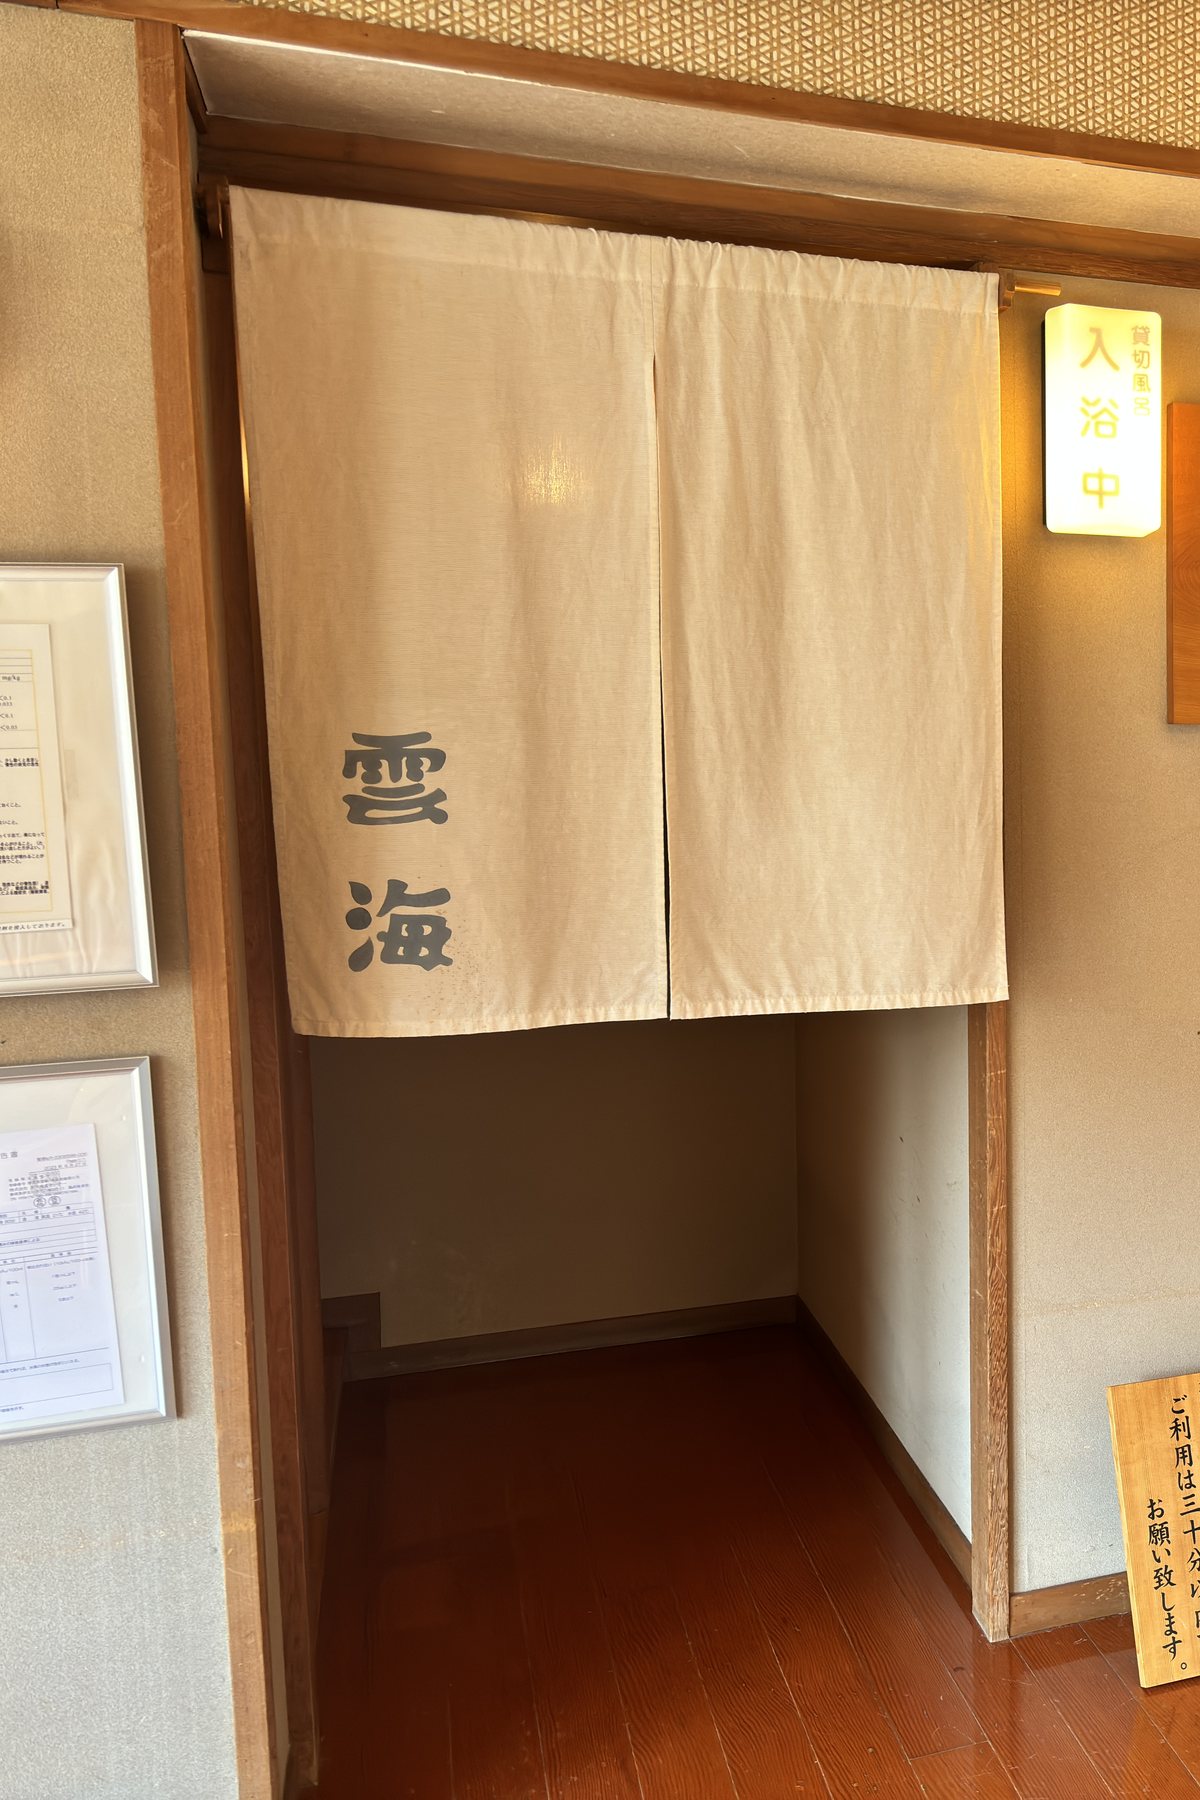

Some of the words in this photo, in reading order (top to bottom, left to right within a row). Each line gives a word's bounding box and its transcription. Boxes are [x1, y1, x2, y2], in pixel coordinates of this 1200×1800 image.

[1079, 326, 1120, 510] 入浴中
[1131, 325, 1151, 416] 貸切風呂
[342, 731, 453, 972] 雲海
[1147, 1498, 1188, 1670] お願い致します。
